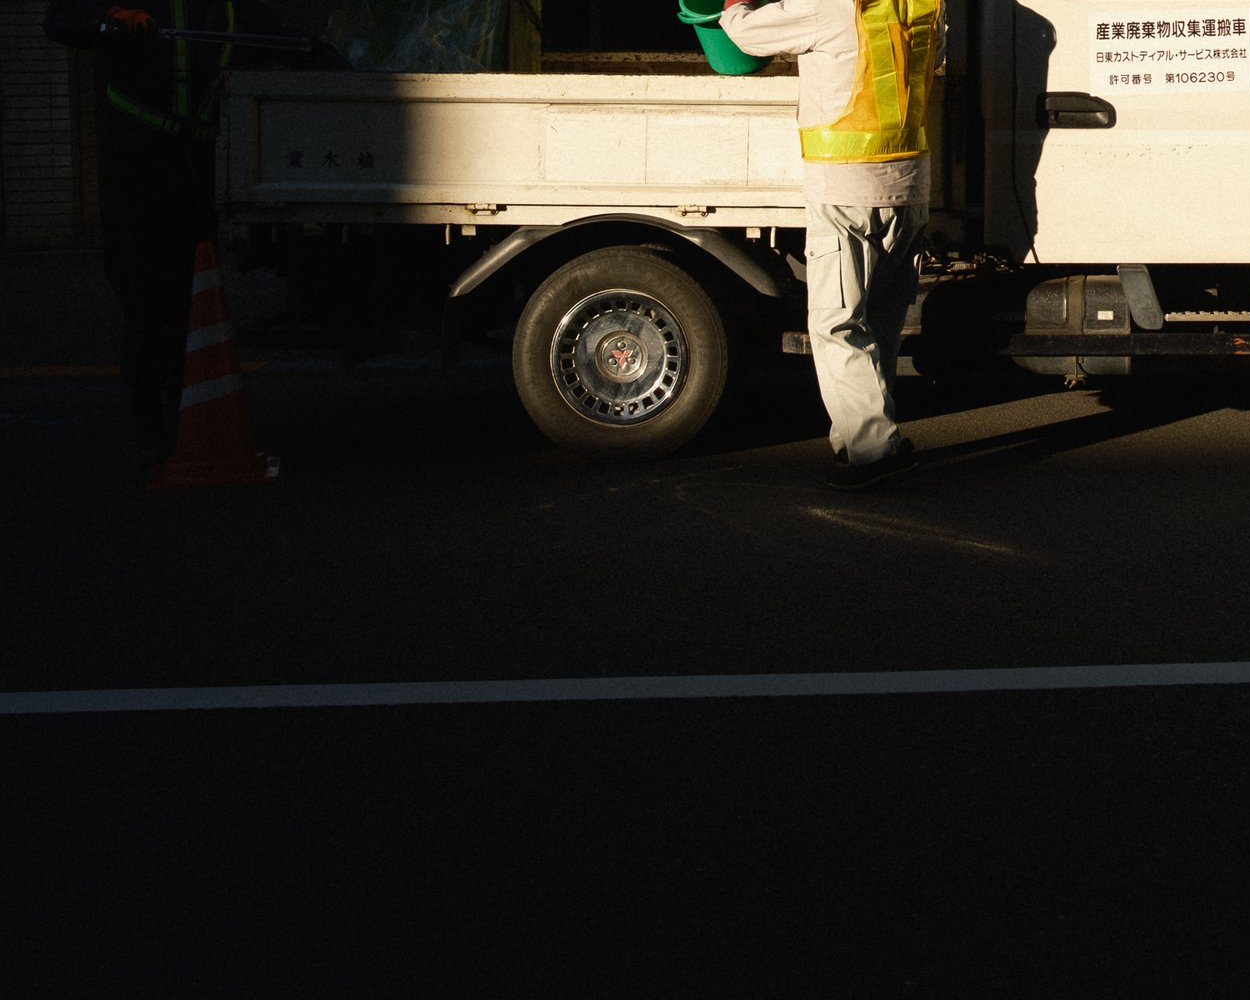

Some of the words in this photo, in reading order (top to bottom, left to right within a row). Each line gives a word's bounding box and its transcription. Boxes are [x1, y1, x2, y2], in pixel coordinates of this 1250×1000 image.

[1096, 18, 1247, 40] 産業廃棄物収集運搬車
[1096, 48, 1247, 63] 日東カストディアル・サービス株式会社
[1109, 73, 1153, 86] 許可番号
[1165, 71, 1236, 84] 第106230号
